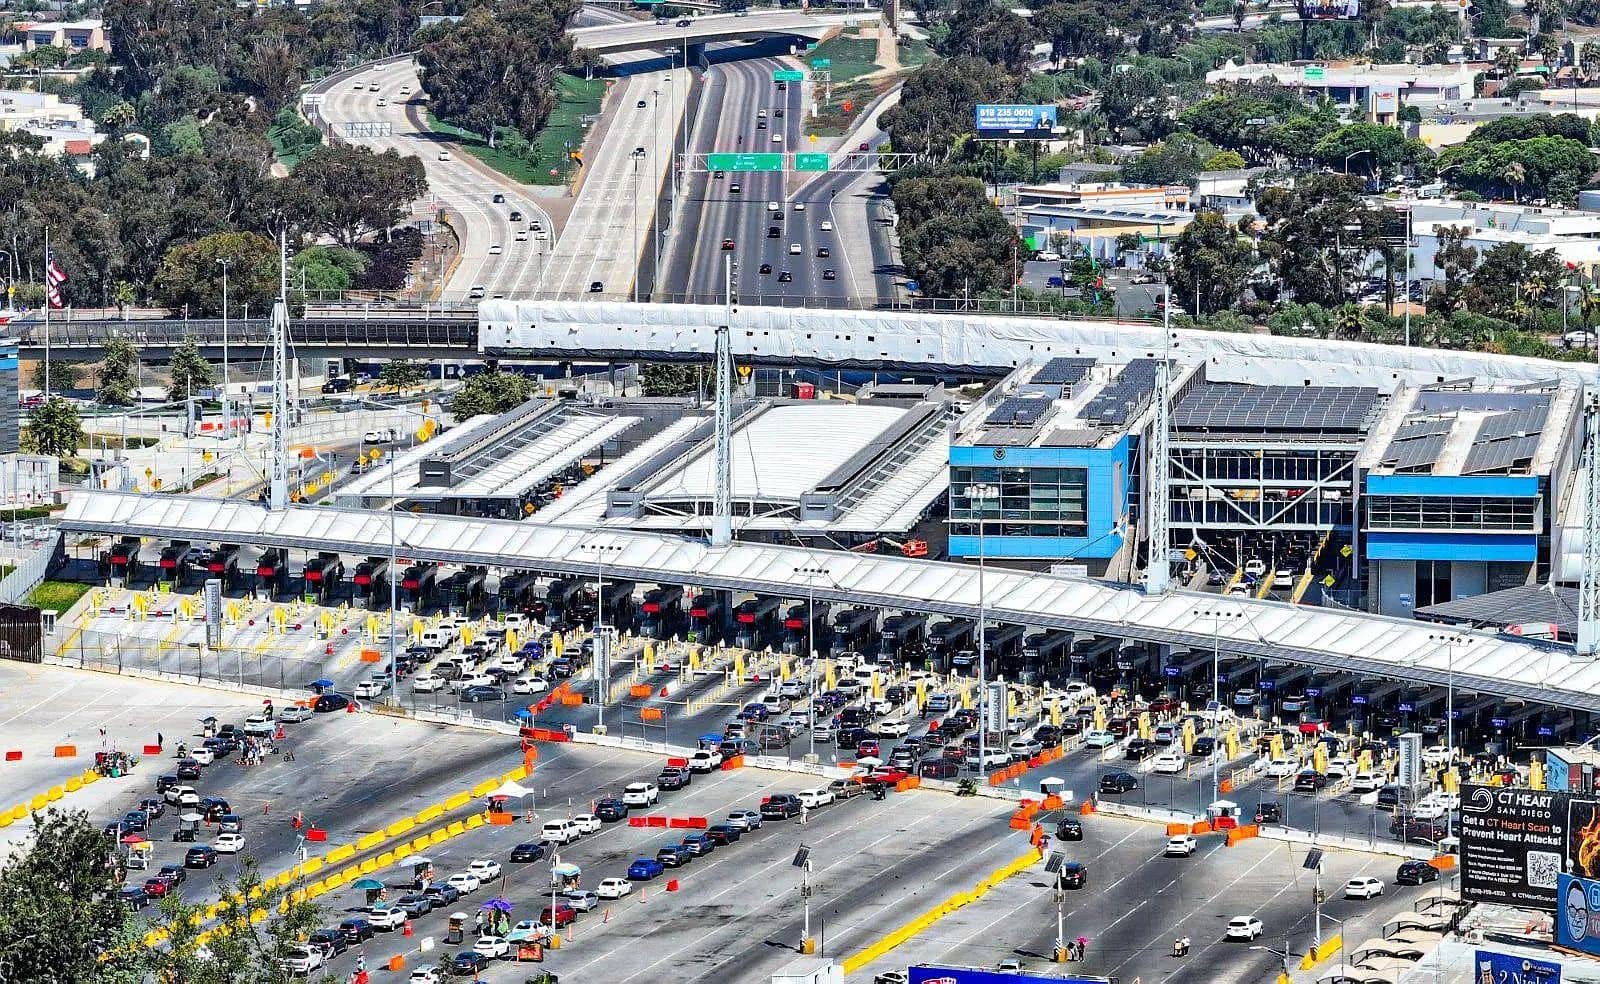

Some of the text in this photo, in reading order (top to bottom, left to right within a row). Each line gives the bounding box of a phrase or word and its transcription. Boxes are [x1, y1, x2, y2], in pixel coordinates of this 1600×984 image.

[1498, 791, 1553, 809] CT HEART
[1497, 807, 1551, 818] SAN DIEGO
[1462, 814, 1562, 834] Get a CT Heart Scan to
[1462, 827, 1562, 846] Prevent Heart Attacks!
